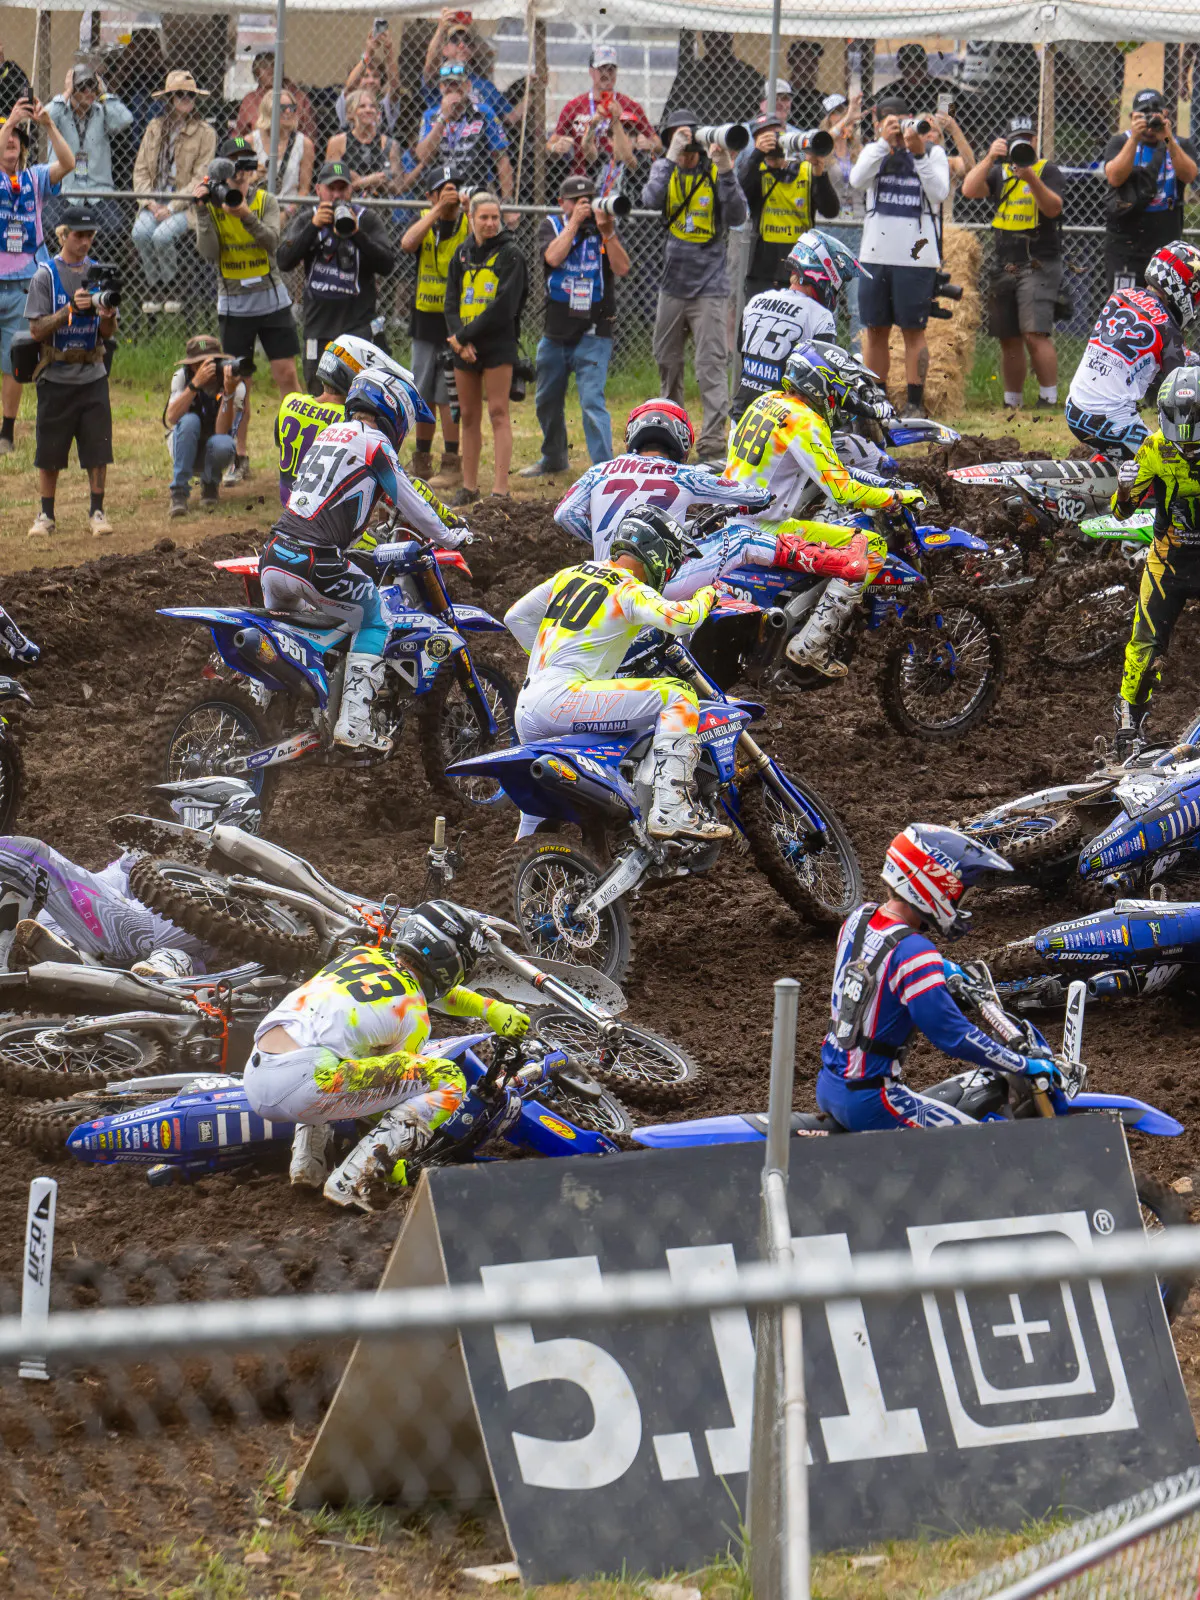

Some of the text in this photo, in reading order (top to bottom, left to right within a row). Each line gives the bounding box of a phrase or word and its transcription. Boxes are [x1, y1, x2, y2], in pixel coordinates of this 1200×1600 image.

[878, 192, 921, 206] SEASON
[765, 224, 792, 234] FRONT
[419, 293, 444, 304] FRONT
[751, 297, 803, 318] SPANGLE
[743, 312, 803, 361] 113
[1088, 298, 1162, 363] 832
[824, 350, 845, 368] 428
[385, 394, 396, 407] BELL
[733, 410, 776, 467] 428
[292, 445, 348, 497] 951
[601, 458, 678, 476] TOWERS
[1057, 497, 1086, 522] 832
[666, 520, 684, 542] 40
[716, 531, 730, 578] HONDA
[572, 562, 624, 586] ROSS
[544, 577, 610, 632] 40
[277, 631, 308, 668] 951
[550, 693, 625, 723] FLY
[585, 720, 628, 732] YAMAHA
[714, 722, 743, 737] REDLANDS
[576, 753, 607, 778] 40
[539, 845, 571, 854] DUNLOP
[1091, 827, 1124, 858] DUNLOP
[1095, 862, 1132, 878] DUNLOP
[600, 883, 618, 904] Mika
[1052, 917, 1101, 934] DUNLOP
[1058, 952, 1110, 961] DUNLOP
[843, 976, 863, 1002] 146
[501, 1014, 513, 1034] FLY
[110, 1106, 161, 1125] DUNLOP
[27, 1219, 42, 1283] UFO
[39, 1229, 47, 1288] PLAST
[479, 1232, 928, 1491] 5.11
